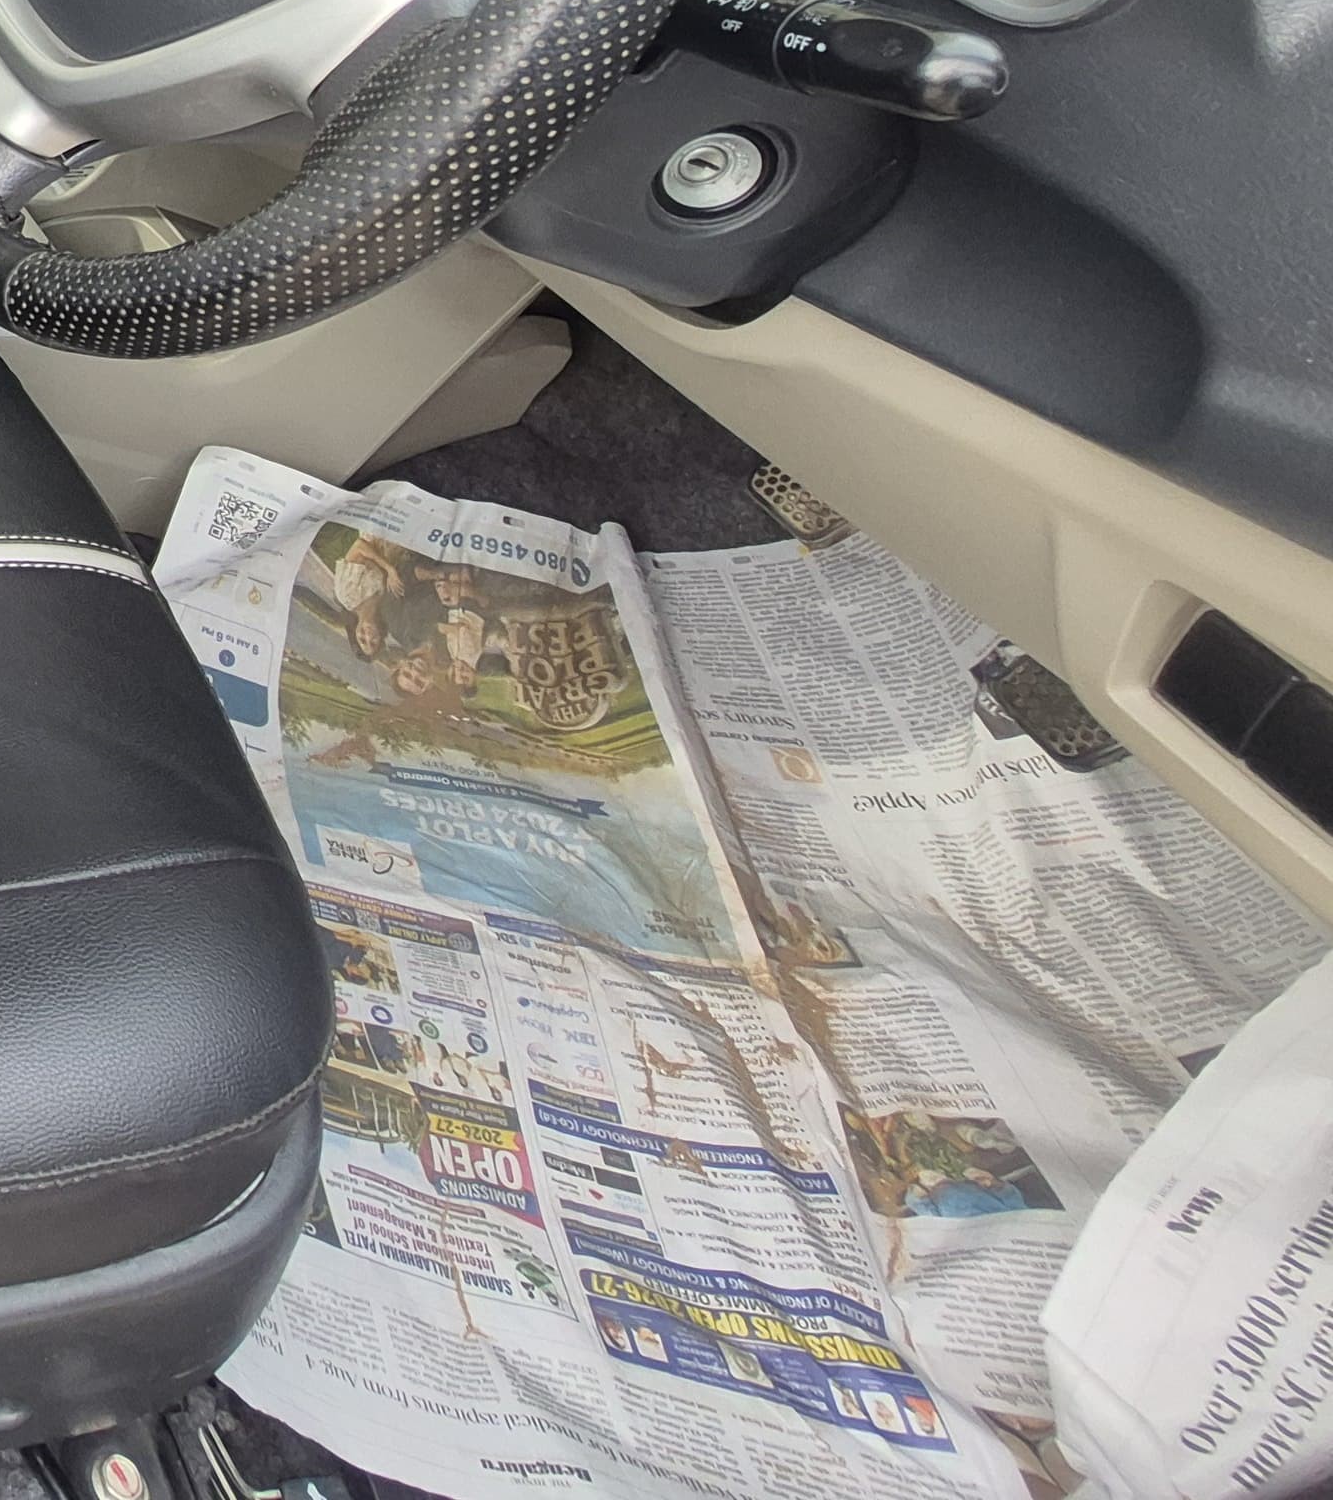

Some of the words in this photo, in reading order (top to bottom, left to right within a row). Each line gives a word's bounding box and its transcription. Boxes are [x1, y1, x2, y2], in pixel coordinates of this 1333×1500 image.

[721, 18, 744, 33] OFF
[783, 32, 814, 51] OFF
[470, 534, 529, 560] 4568
[534, 550, 567, 573] 080
[201, 626, 215, 637] PM
[216, 632, 223, 642] 6
[225, 634, 235, 643] to
[237, 638, 251, 649] AM
[507, 612, 605, 656] FEST
[252, 645, 260, 656] 9
[509, 643, 610, 686] PLOT
[512, 671, 622, 712] GREAT
[552, 703, 587, 722] THE
[723, 709, 795, 731] Savoury
[1003, 754, 1058, 778] labs
[378, 788, 486, 821] PRICES
[853, 792, 927, 813] Apple?
[414, 816, 492, 846] PLOT
[491, 805, 566, 836] 2024
[327, 840, 366, 856] INFRA
[494, 828, 517, 848] A
[329, 849, 369, 864] KNS
[508, 952, 571, 975] accenture
[436, 1119, 503, 1145] 2026-27
[536, 1108, 579, 1136] (Co-Ed)
[582, 1124, 662, 1152] TECHNOLOGY
[429, 1134, 523, 1191] OPEN
[440, 1178, 526, 1209] ADMISSIONS
[346, 1198, 426, 1240] Management
[353, 1216, 366, 1231] of
[1165, 1186, 1224, 1235] News
[341, 1227, 377, 1255] PATEL
[369, 1222, 410, 1250] School
[428, 1228, 438, 1242] &
[442, 1232, 492, 1257] Textiles
[412, 1239, 496, 1274] International
[575, 1236, 629, 1263] (Women)
[461, 1269, 513, 1296] SARDAR
[632, 1258, 714, 1288] TECHNOLOGY
[714, 1276, 726, 1288] &
[589, 1273, 684, 1319] 2026-27
[643, 1277, 711, 1305] OFFERED
[813, 1295, 831, 1310] OF
[685, 1304, 750, 1338] OPEN
[751, 1316, 903, 1371] ADMISSIONS
[305, 1354, 315, 1369] 4
[318, 1359, 358, 1389] Aug.
[1181, 1383, 1244, 1455] Over
[1213, 1295, 1289, 1395] 3,000
[361, 1378, 410, 1408] from
[411, 1396, 502, 1426] aspirants
[503, 1412, 584, 1445] medical
[1232, 1411, 1305, 1492] move
[1272, 1365, 1327, 1422] SC
[588, 1438, 618, 1462] for
[479, 1458, 593, 1484] Bengaluru
